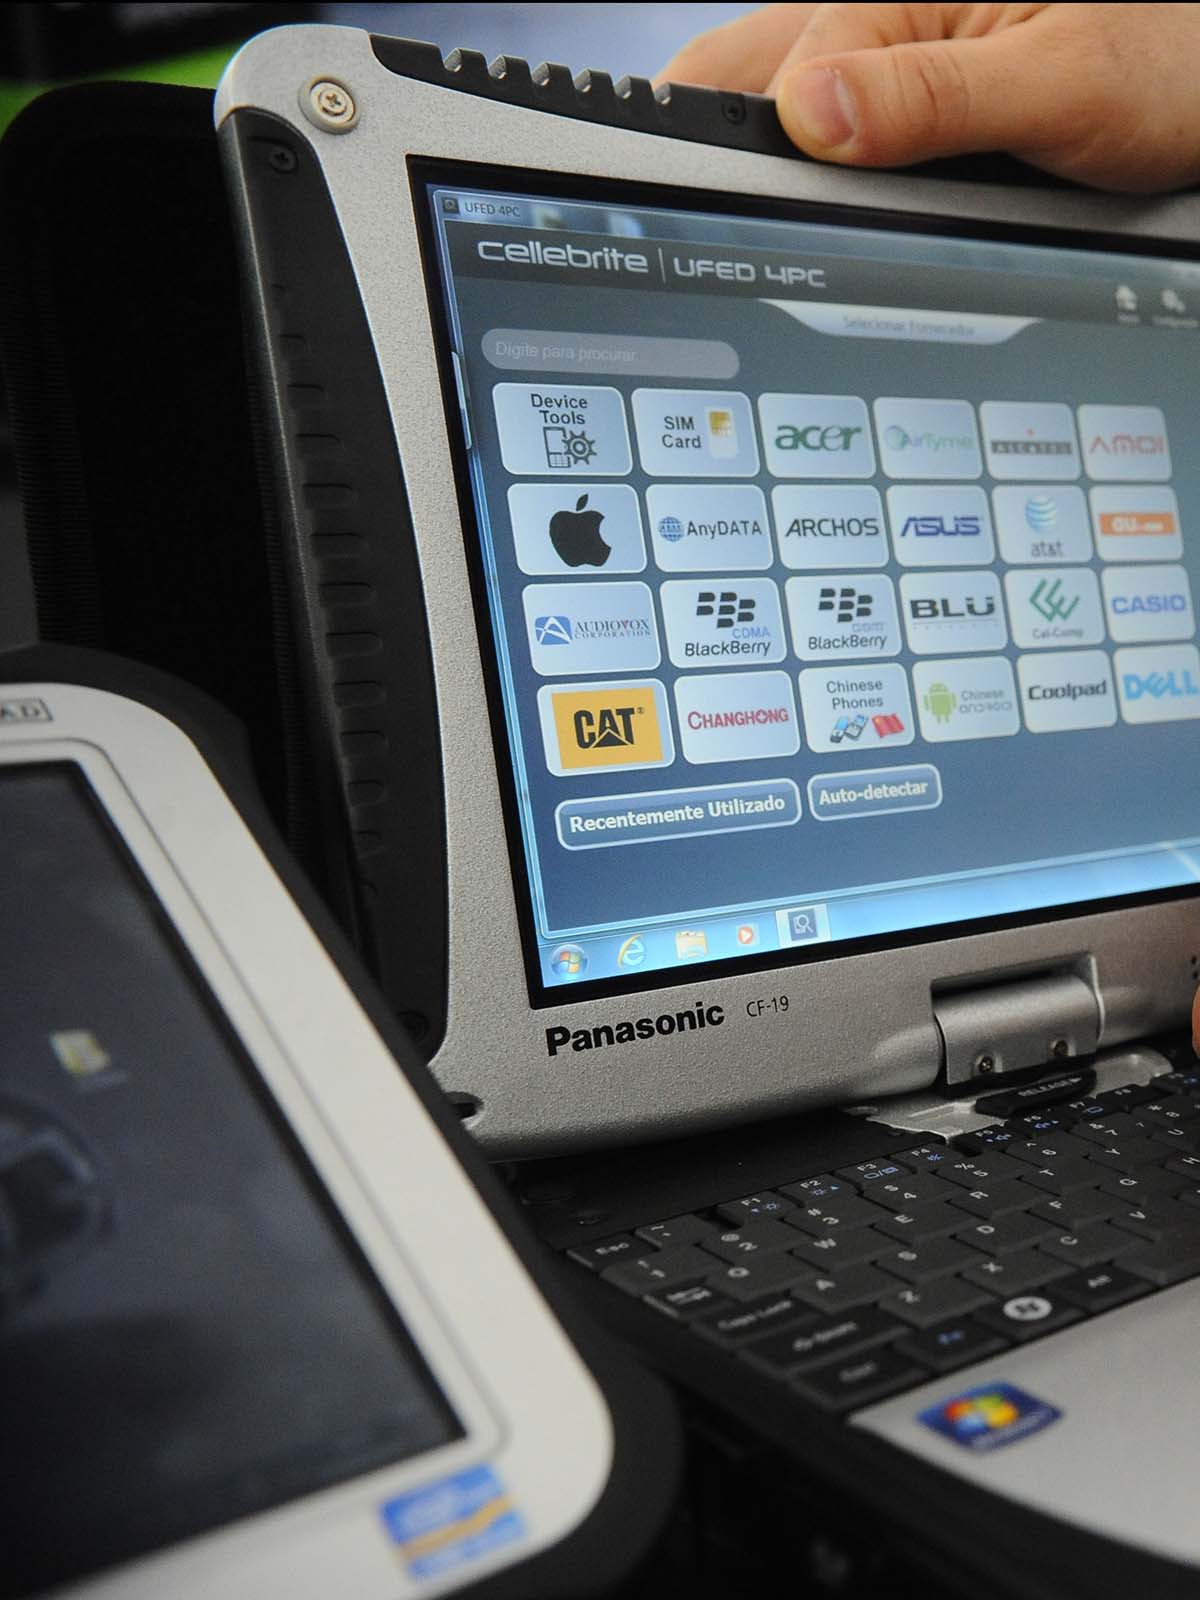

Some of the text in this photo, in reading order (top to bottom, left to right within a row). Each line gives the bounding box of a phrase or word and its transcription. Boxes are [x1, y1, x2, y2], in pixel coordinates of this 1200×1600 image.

[465, 202, 521, 218] UFED 4PC
[477, 239, 649, 273] cellebrite
[673, 259, 827, 289] UFED 4PC
[495, 341, 539, 362] Digite
[542, 347, 574, 365] para
[531, 393, 588, 410] Device
[539, 411, 586, 426] Tools
[663, 416, 695, 431] SIM
[662, 434, 702, 449] Card
[775, 424, 862, 451] acer
[687, 520, 763, 540] AnyDATA
[785, 518, 880, 538] ARCHOS
[900, 515, 981, 538] ASUS
[1111, 594, 1187, 615] CASIO
[574, 619, 651, 634] AUDIOVOX
[732, 626, 771, 640] CDMA
[684, 639, 772, 658] BlackBerry
[808, 632, 888, 651] BlackBerry
[826, 679, 883, 694] Chinese
[1027, 679, 1108, 702] Coolpad
[831, 695, 884, 711] Phones
[818, 779, 929, 807] Auto-detectar
[569, 794, 786, 834] Recentemente Utilizado
[545, 995, 790, 1057] Panasonic CF-19
